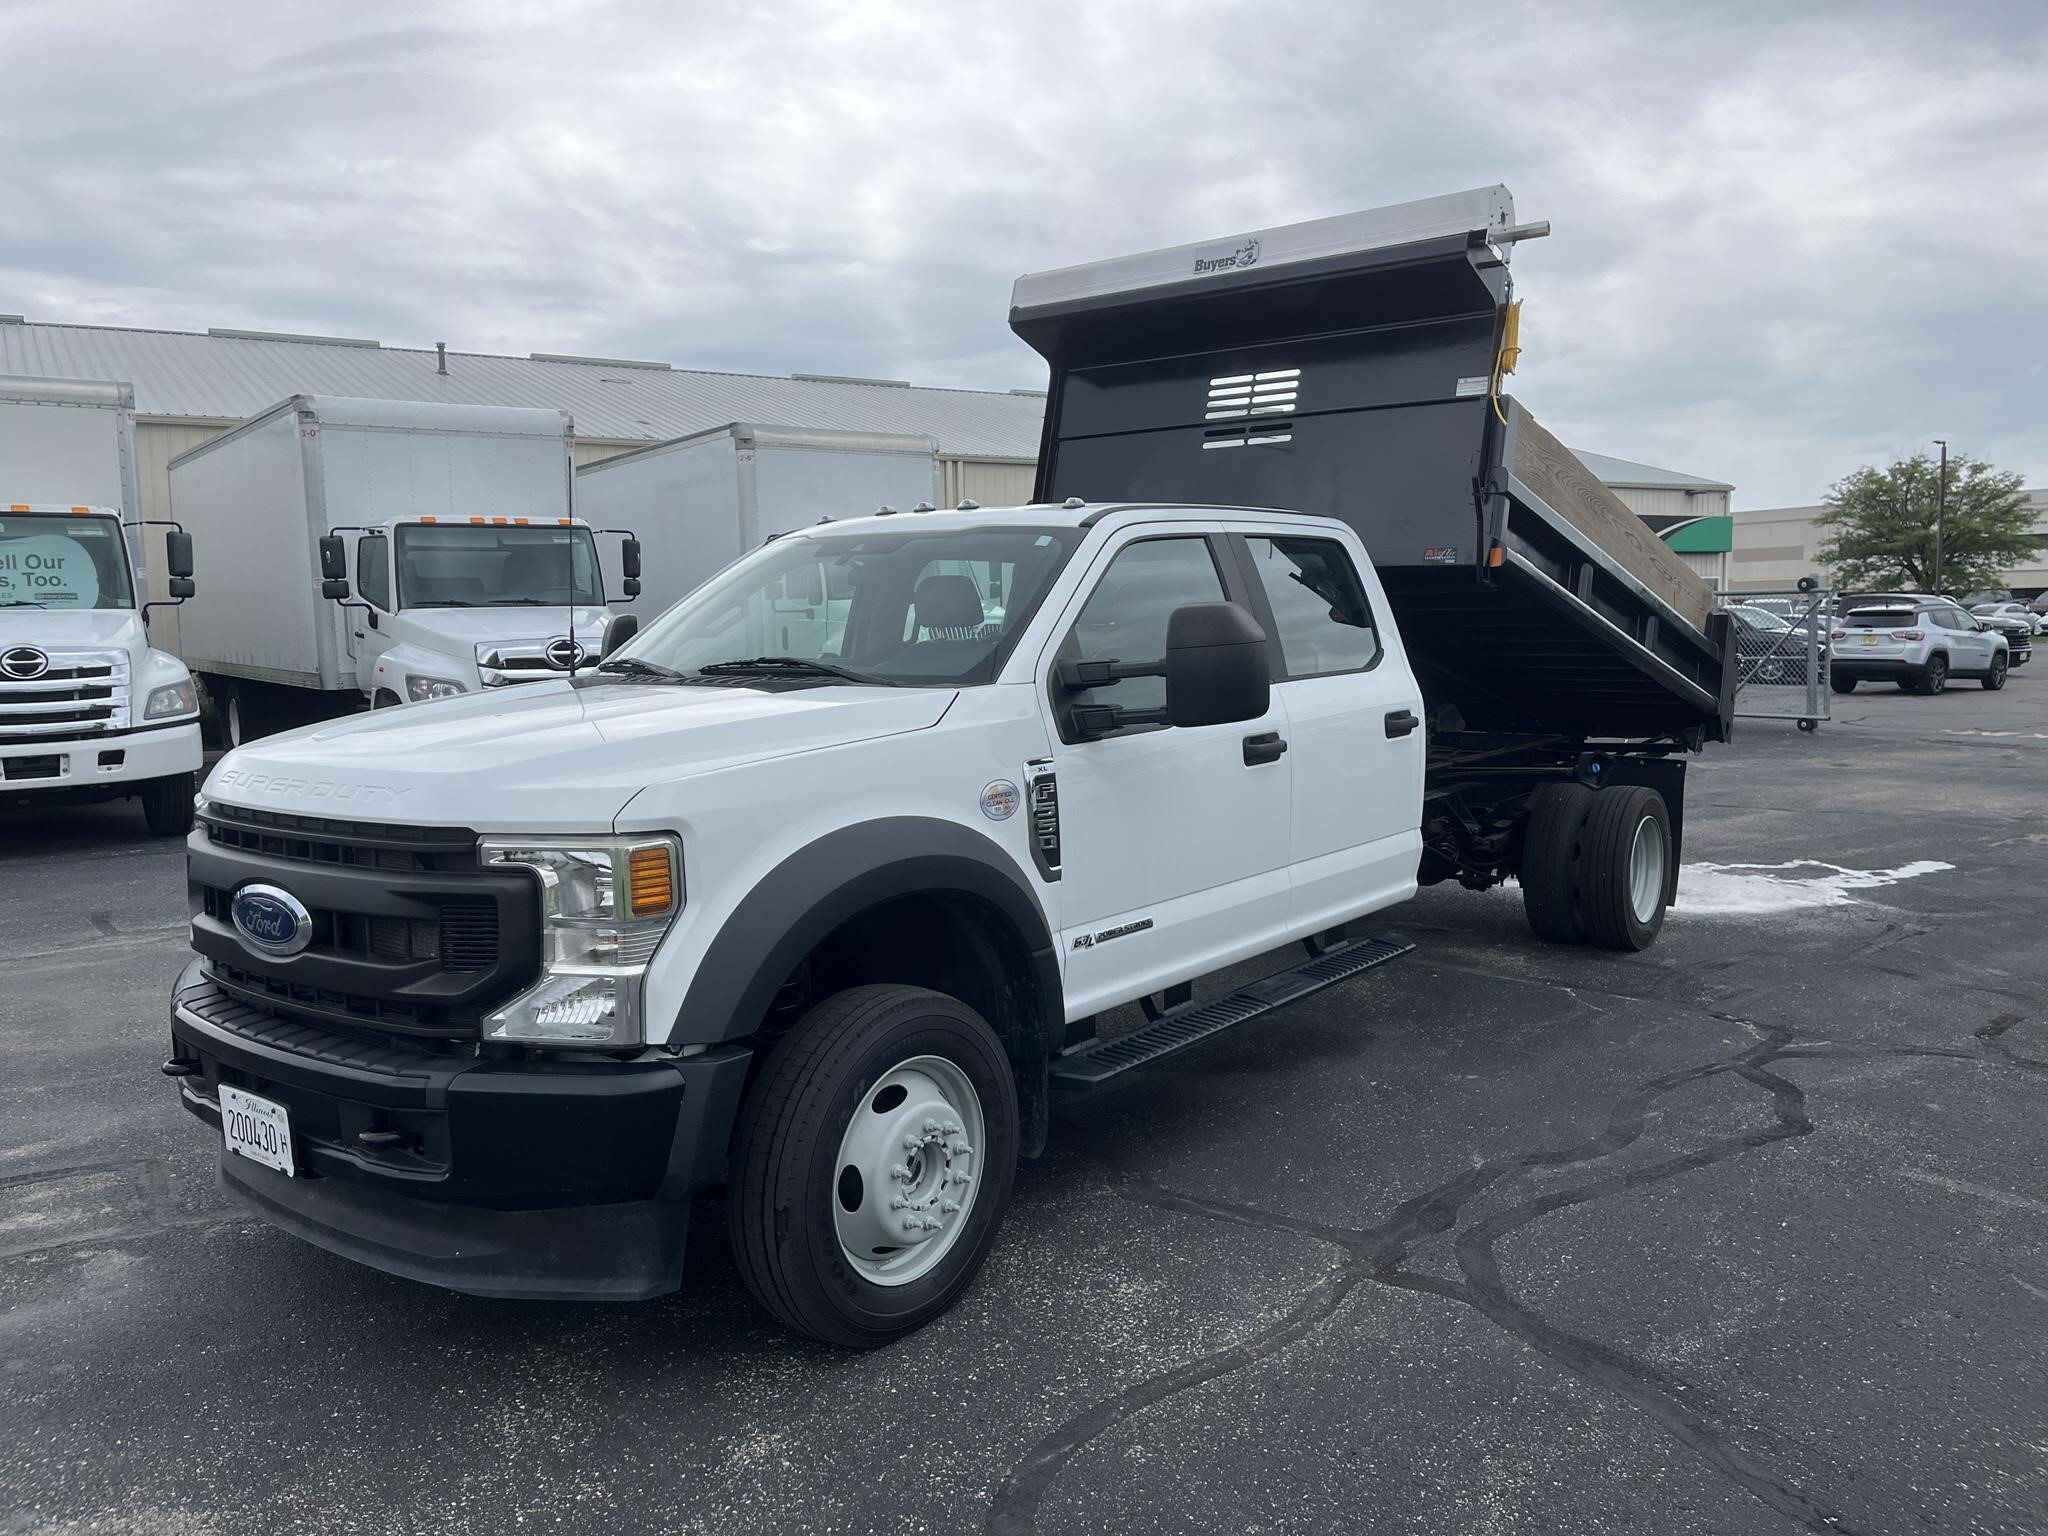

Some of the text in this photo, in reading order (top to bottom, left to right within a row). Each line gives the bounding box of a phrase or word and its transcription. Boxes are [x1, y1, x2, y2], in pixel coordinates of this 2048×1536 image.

[1194, 256, 1237, 273] Buyers
[25, 554, 65, 570] Our
[21, 572, 67, 587] Too.
[219, 769, 412, 805] SUPER DUTY
[243, 899, 283, 937] Ford
[1097, 926, 1124, 940] POWER
[1124, 918, 1152, 933] STROKE
[243, 1099, 274, 1119] Illinois
[228, 1108, 278, 1155] 200430
